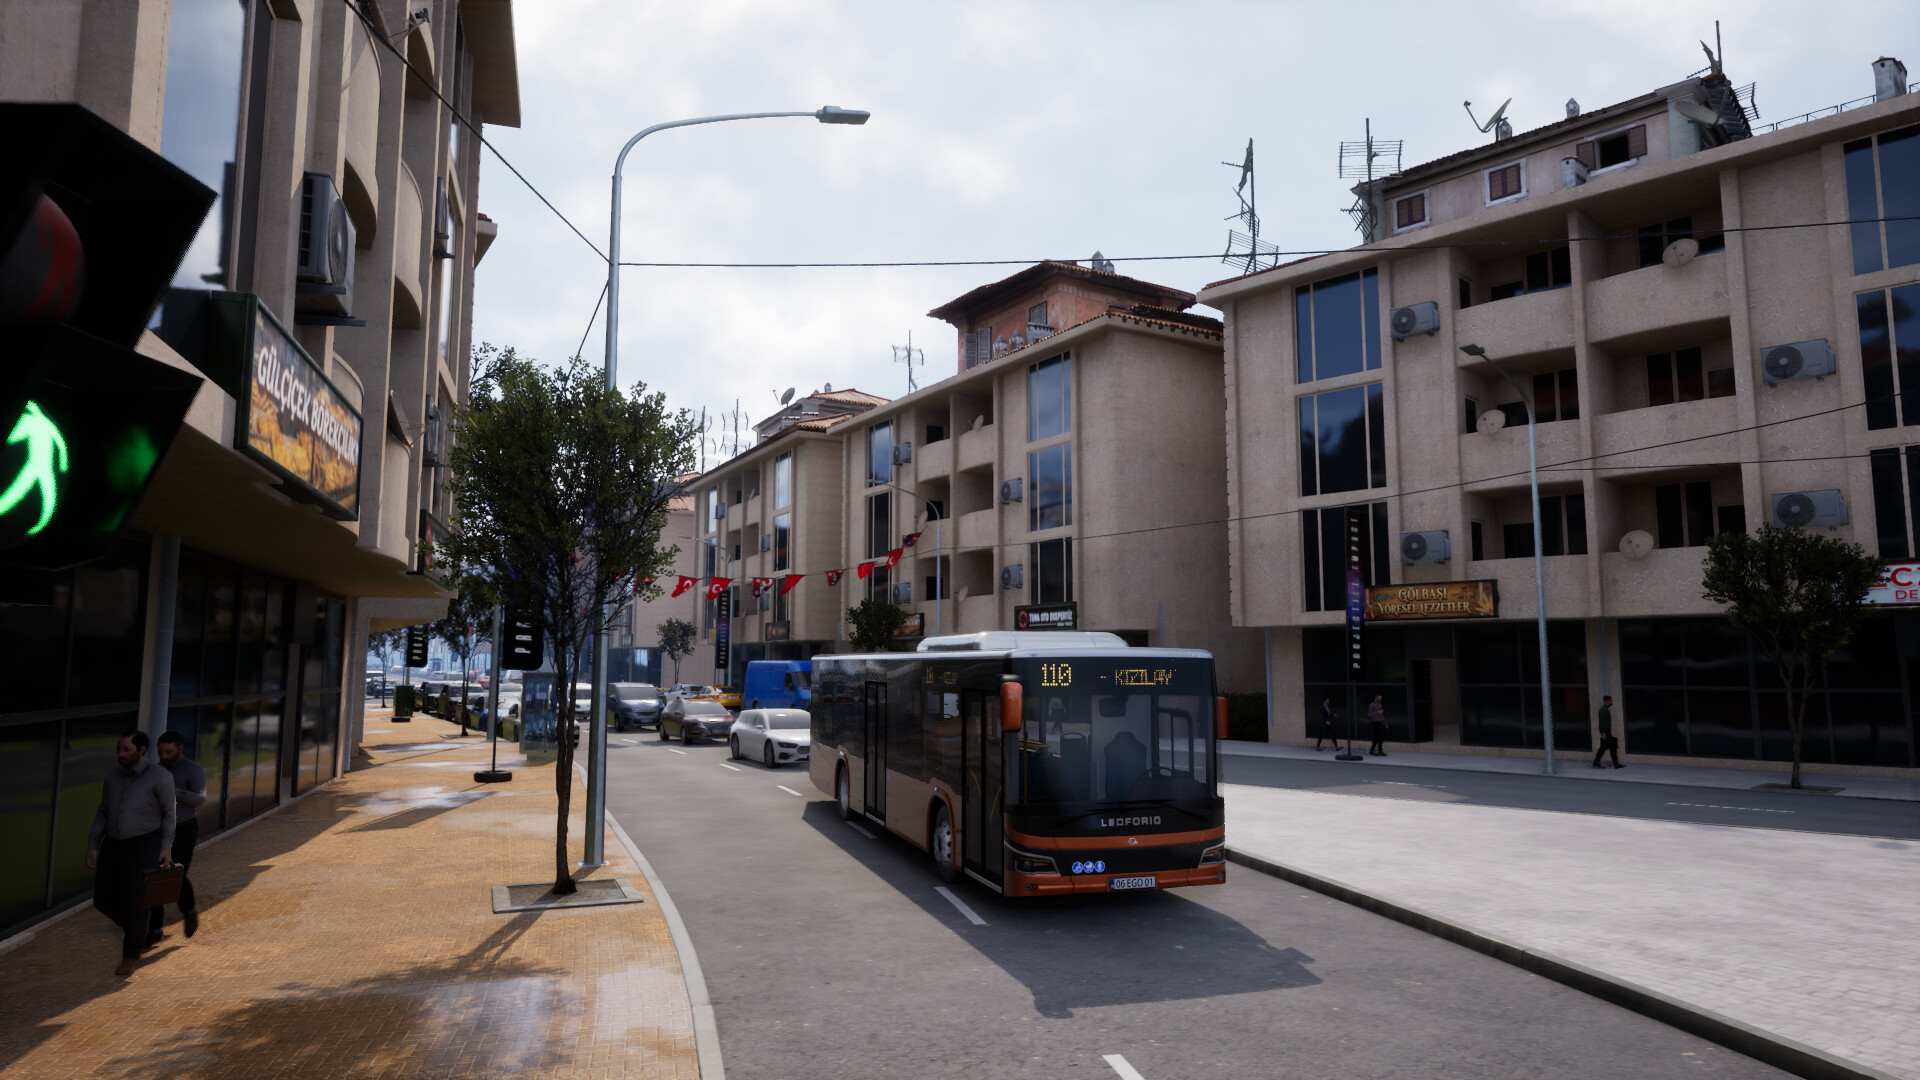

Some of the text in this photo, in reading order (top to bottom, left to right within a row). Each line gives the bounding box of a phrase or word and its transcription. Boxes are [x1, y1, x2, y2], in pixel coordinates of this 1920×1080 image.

[257, 344, 311, 427] GÜLÇİÇEK
[1398, 587, 1448, 602] GÖLBAŞI
[1377, 601, 1473, 616] YÖRESEL LEZZETLER
[1041, 663, 1072, 687] 110
[1116, 877, 1153, 889] 06 EGO 01
